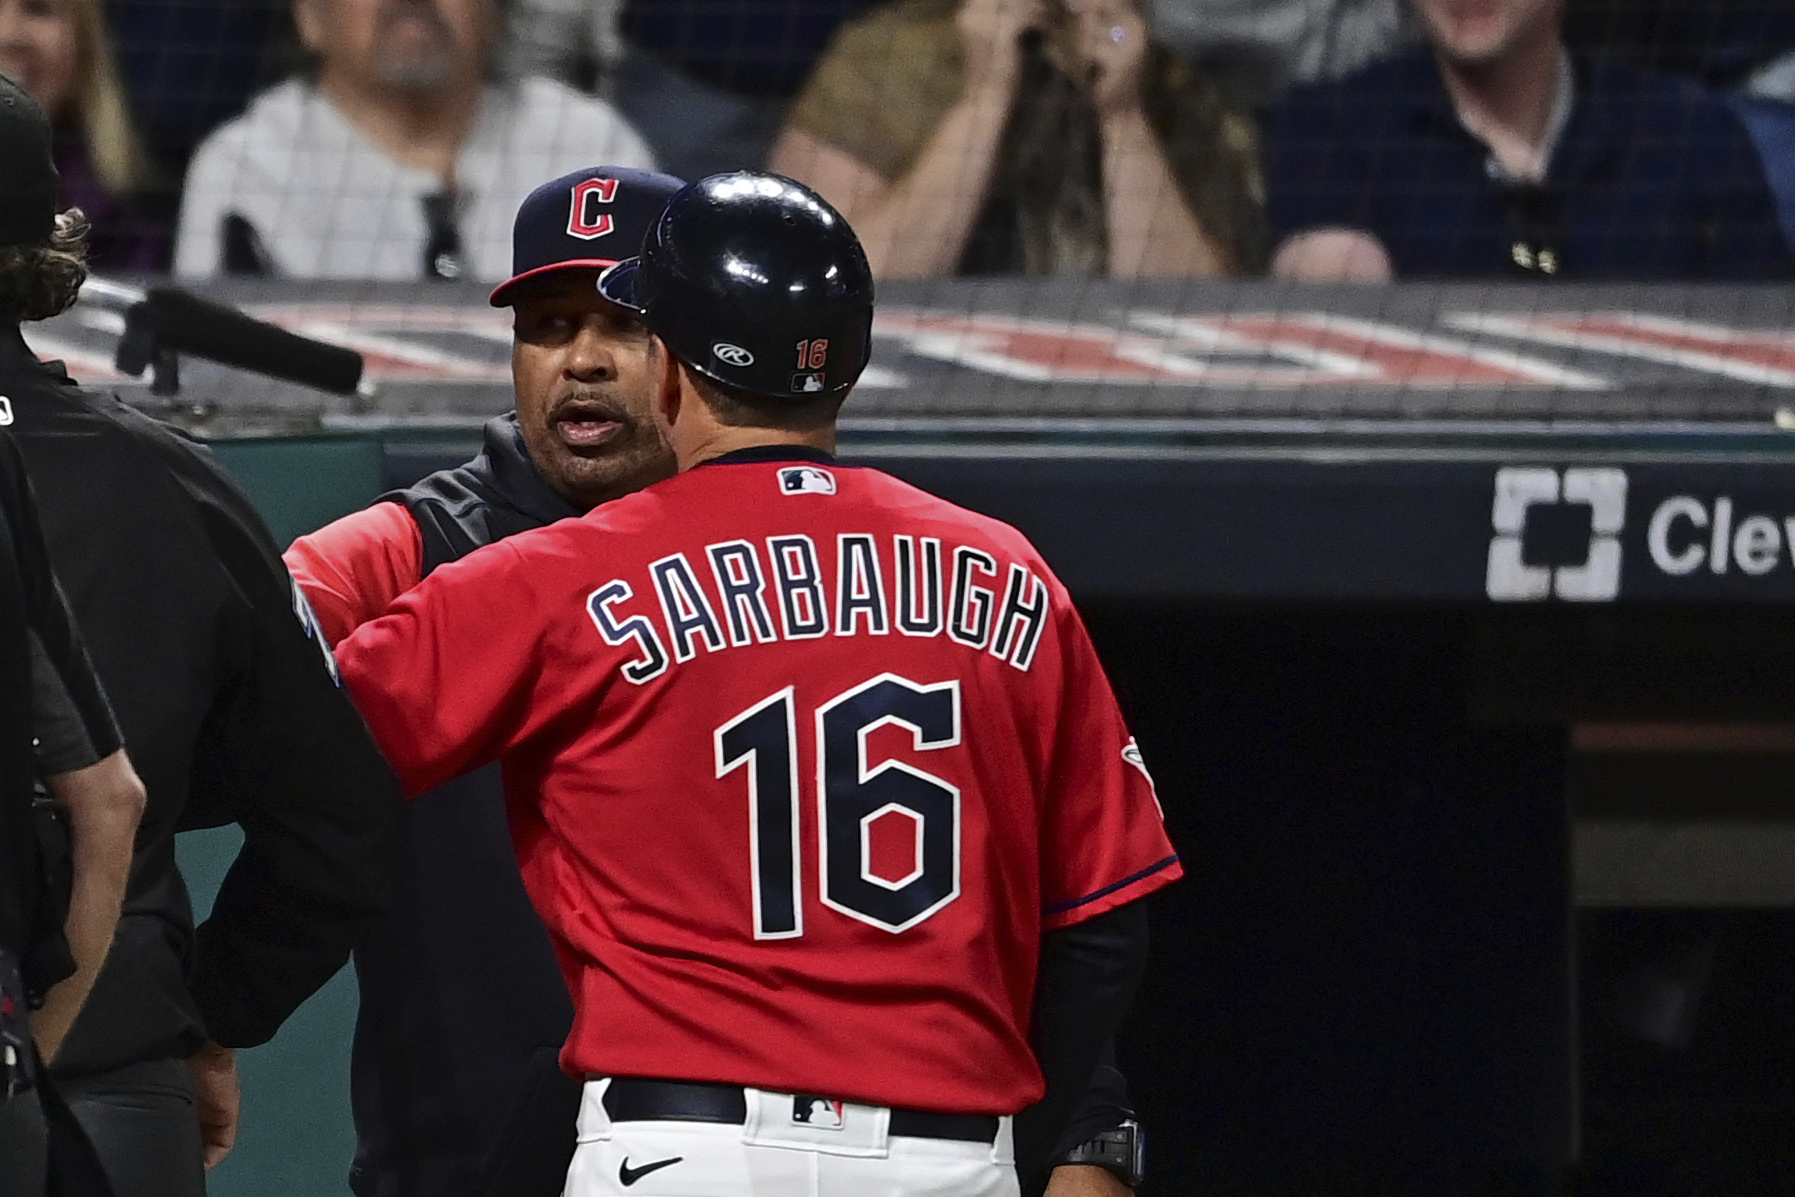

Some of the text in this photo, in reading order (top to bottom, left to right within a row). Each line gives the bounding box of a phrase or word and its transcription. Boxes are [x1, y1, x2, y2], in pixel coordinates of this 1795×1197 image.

[565, 177, 620, 240] C
[796, 338, 829, 369] 16
[586, 533, 1050, 685] SARBAUGH
[713, 671, 962, 941] 16
